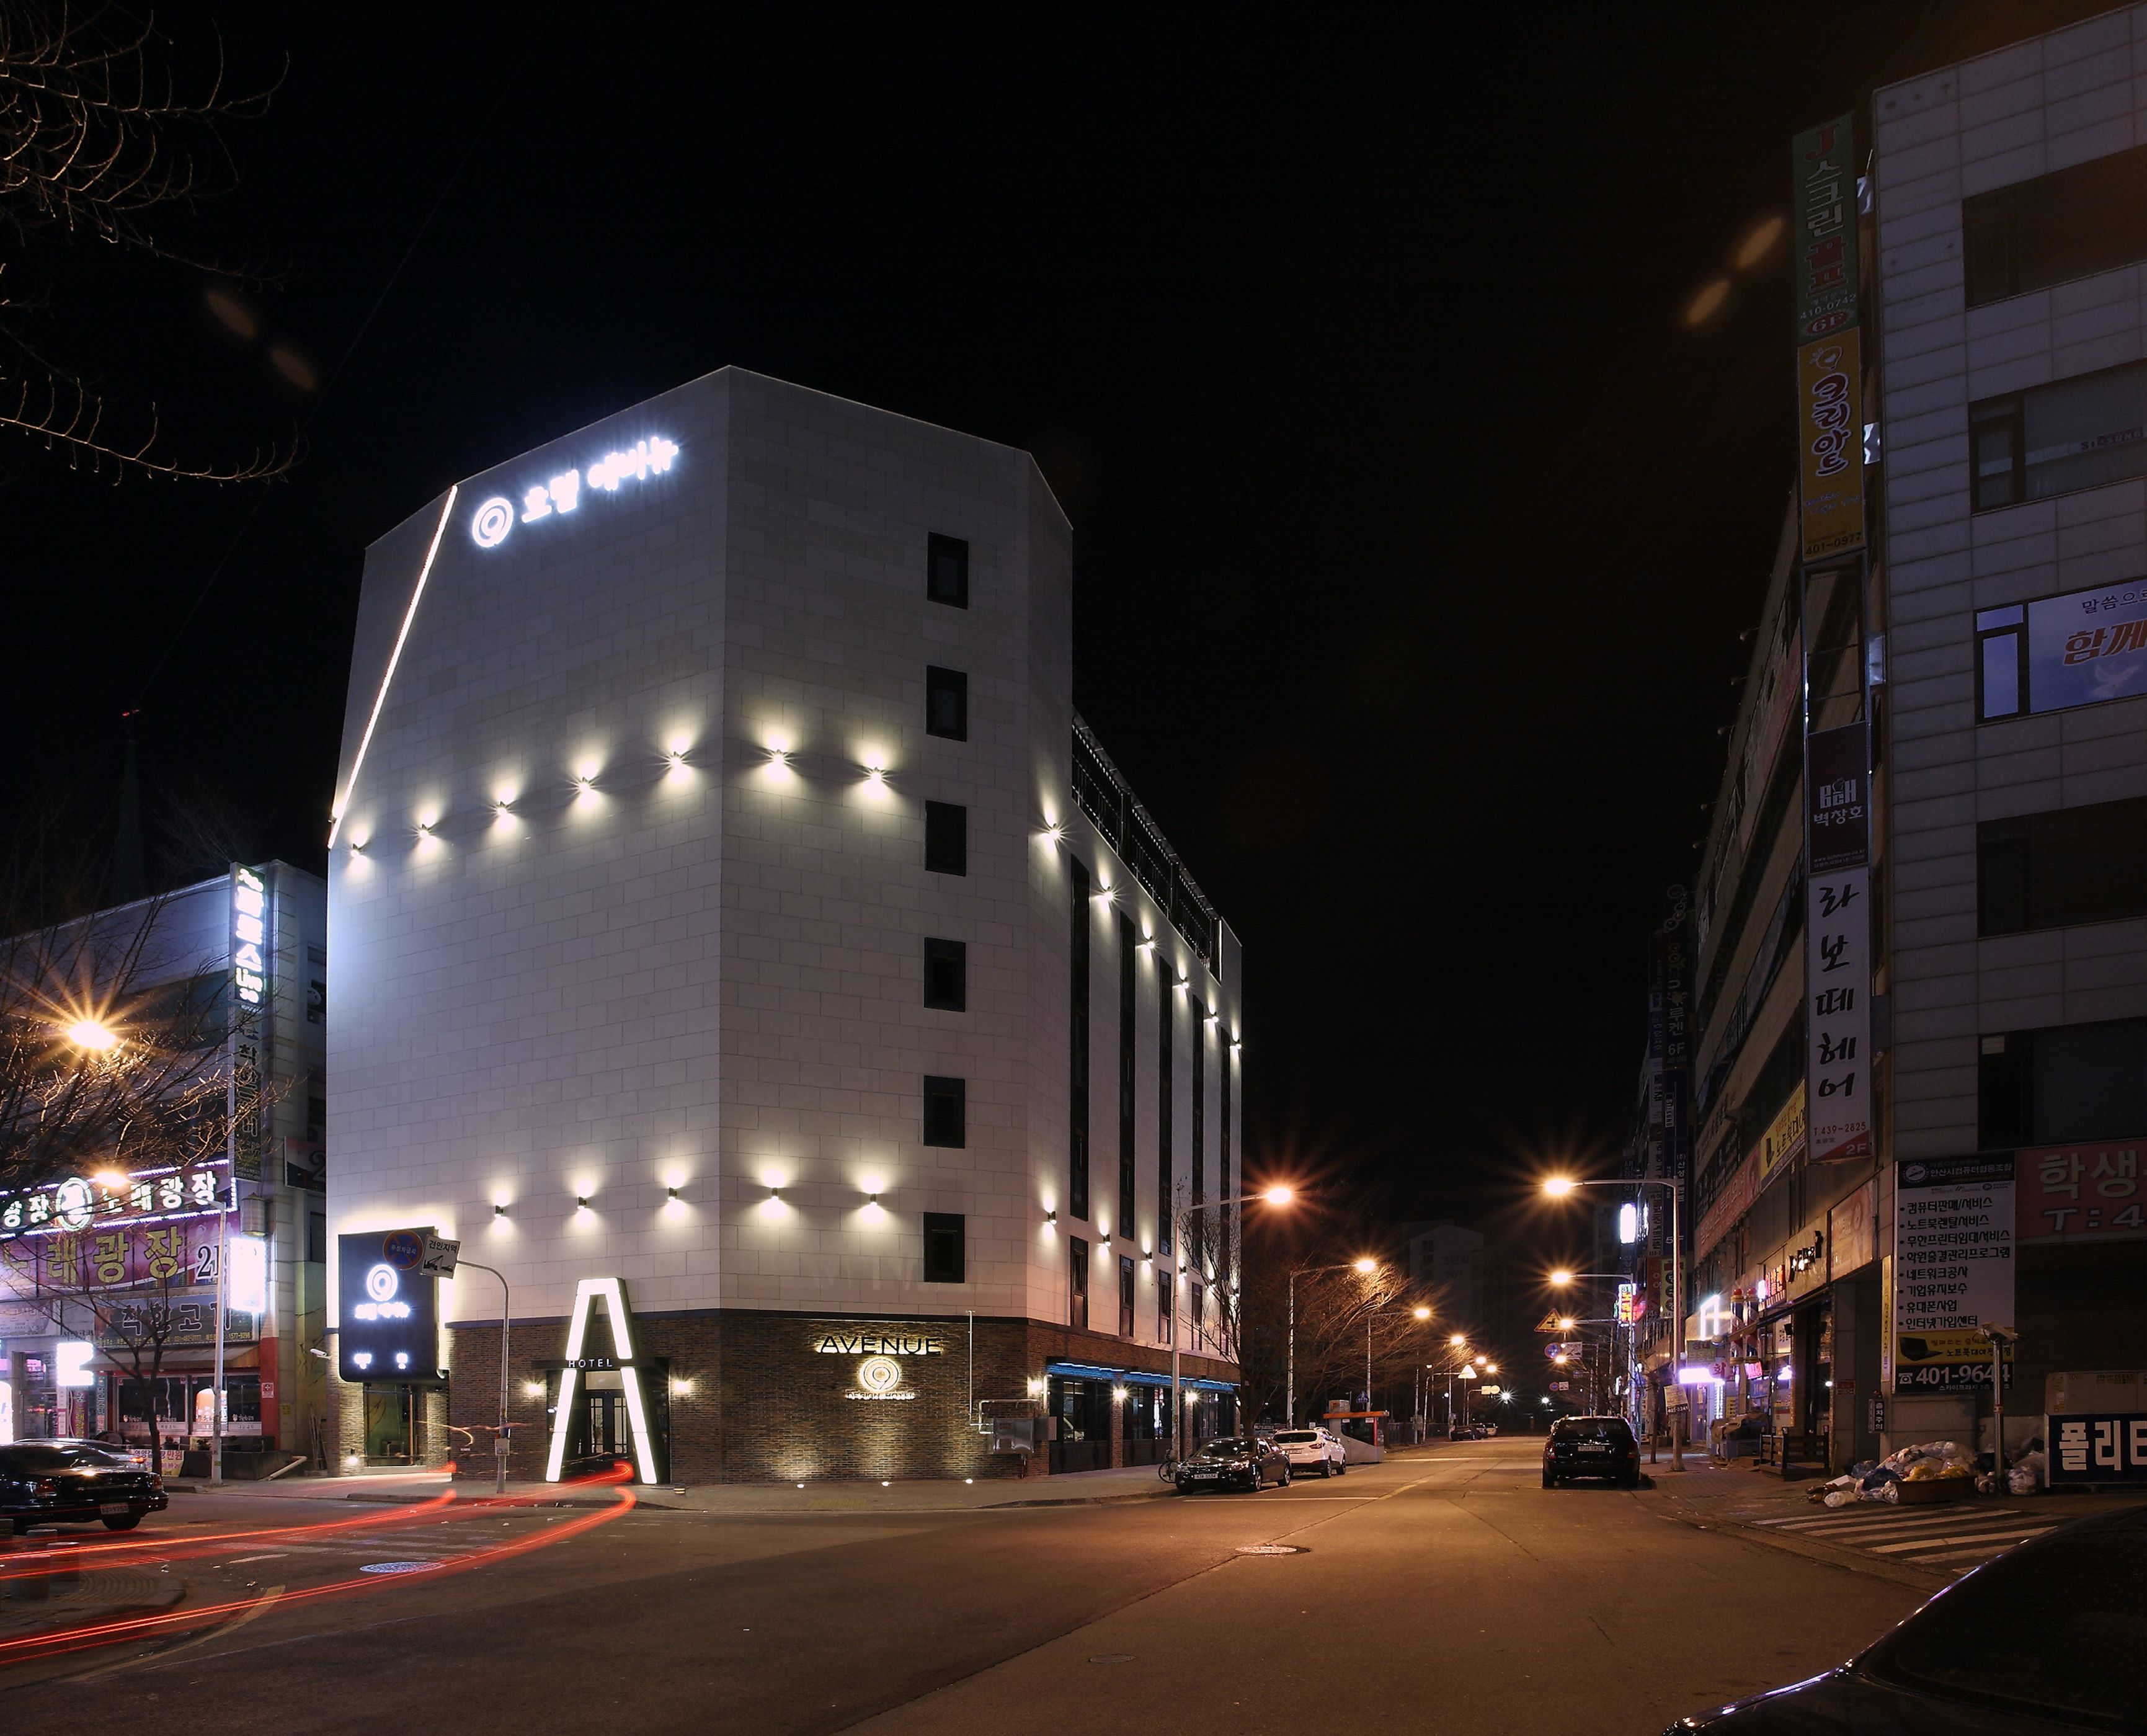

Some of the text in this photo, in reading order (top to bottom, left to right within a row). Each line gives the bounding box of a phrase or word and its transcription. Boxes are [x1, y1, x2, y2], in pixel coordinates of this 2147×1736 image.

[1800, 293, 1857, 319] 410-0742
[1805, 532, 1861, 554] 401-0977
[2063, 620, 2147, 666] 함께
[1813, 805, 1864, 827] 벽창호
[1668, 1042, 1686, 1056] 6F
[1814, 1122, 1866, 1136] T.439-2825
[1846, 1143, 1867, 1155] 2F
[2038, 1149, 2147, 1201] 학생
[101, 1170, 217, 1214] 노래광장
[1907, 1197, 1993, 1214] 컴퓨터판매/서비스
[1907, 1215, 1989, 1230] 노트북렌탈서비스
[429, 1240, 458, 1253] 견인지역
[1906, 1266, 1968, 1280] 네트워크공사
[1906, 1283, 1968, 1297] 기업유지보수
[1905, 1315, 1978, 1330] 인터넷가입센터
[819, 1335, 942, 1356] AVENUE
[1947, 1347, 2011, 1357] 노트북대여전점
[568, 1358, 613, 1368] HOTEL
